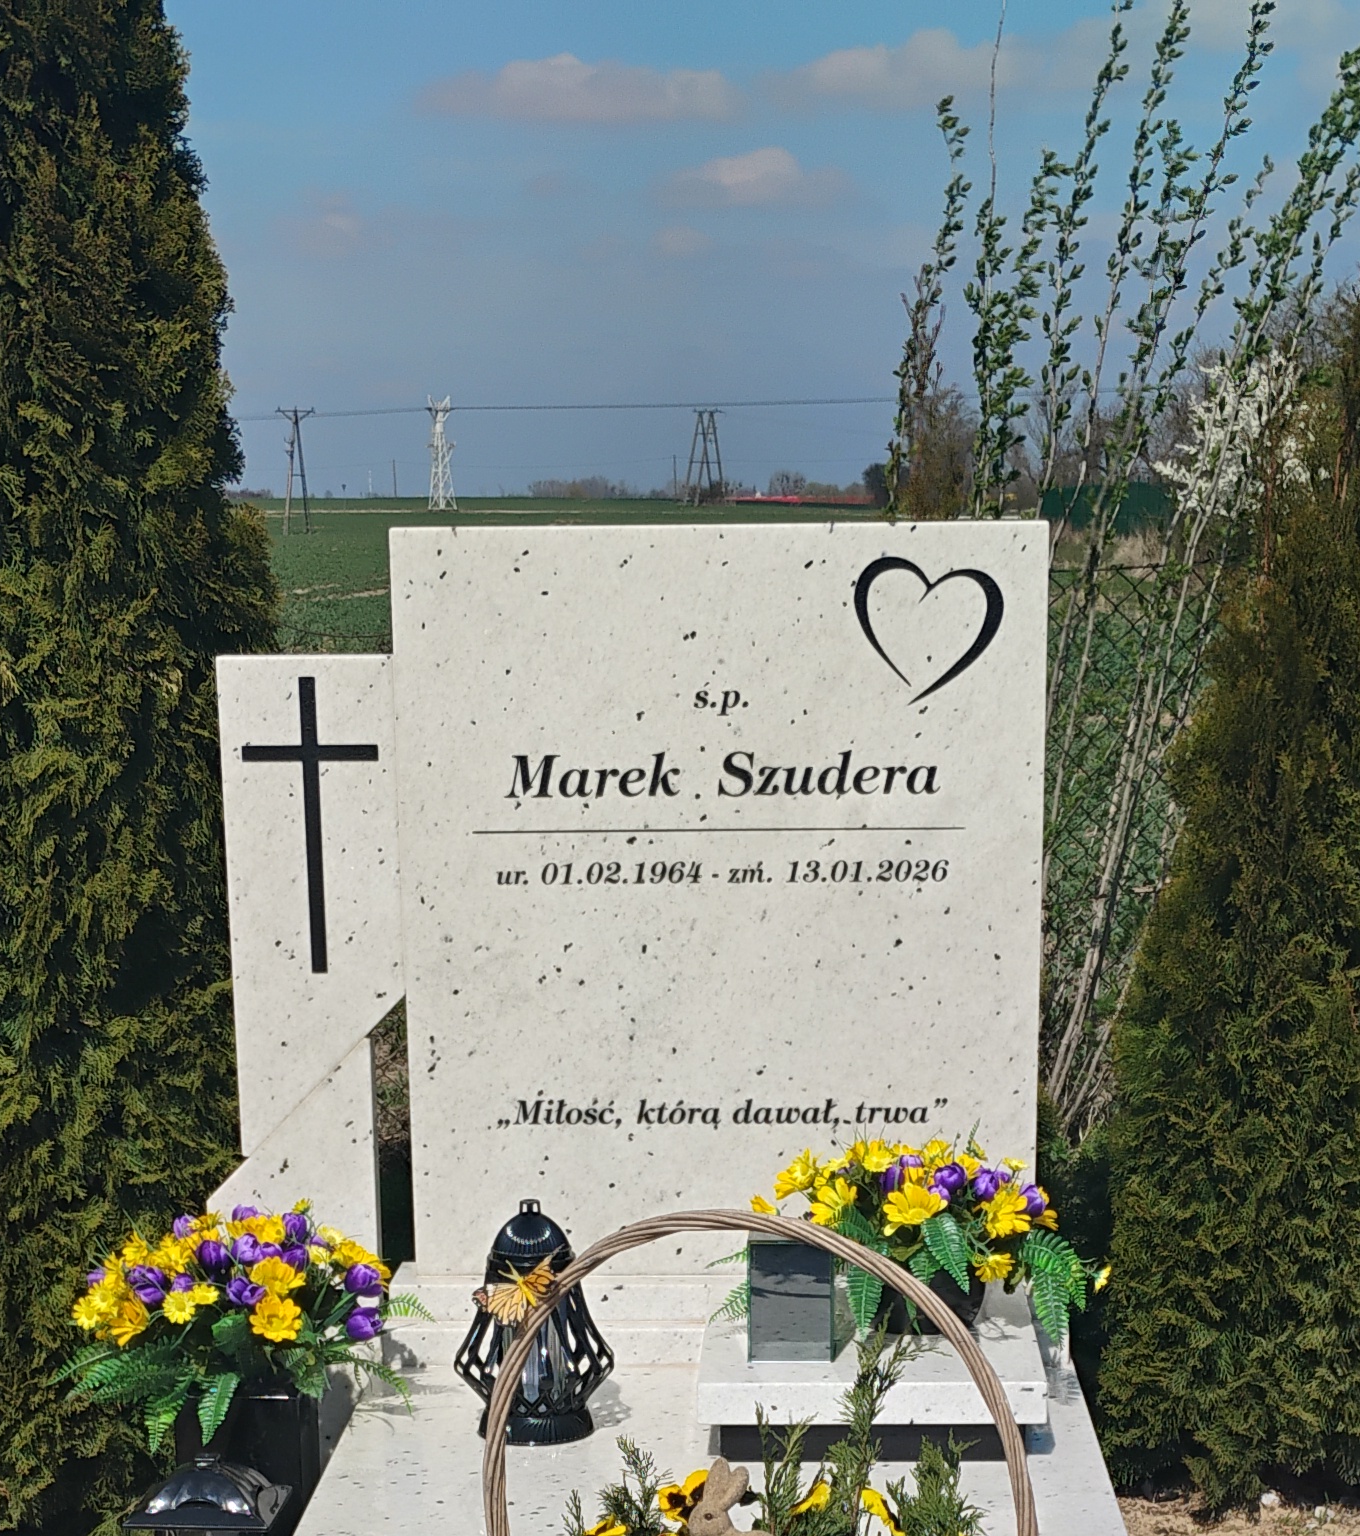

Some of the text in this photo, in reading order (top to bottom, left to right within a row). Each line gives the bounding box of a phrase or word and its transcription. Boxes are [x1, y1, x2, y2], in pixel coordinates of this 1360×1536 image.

[693, 681, 749, 717] ś.p.
[504, 750, 941, 799] Marek Szudera
[495, 867, 529, 885] ur.
[541, 860, 703, 886] 01.02.1964
[728, 865, 773, 884] zm.
[786, 859, 949, 884] 13.01.2026
[496, 1097, 622, 1130] „Miłość,
[636, 1097, 720, 1130] którą
[732, 1097, 840, 1127] dawał,
